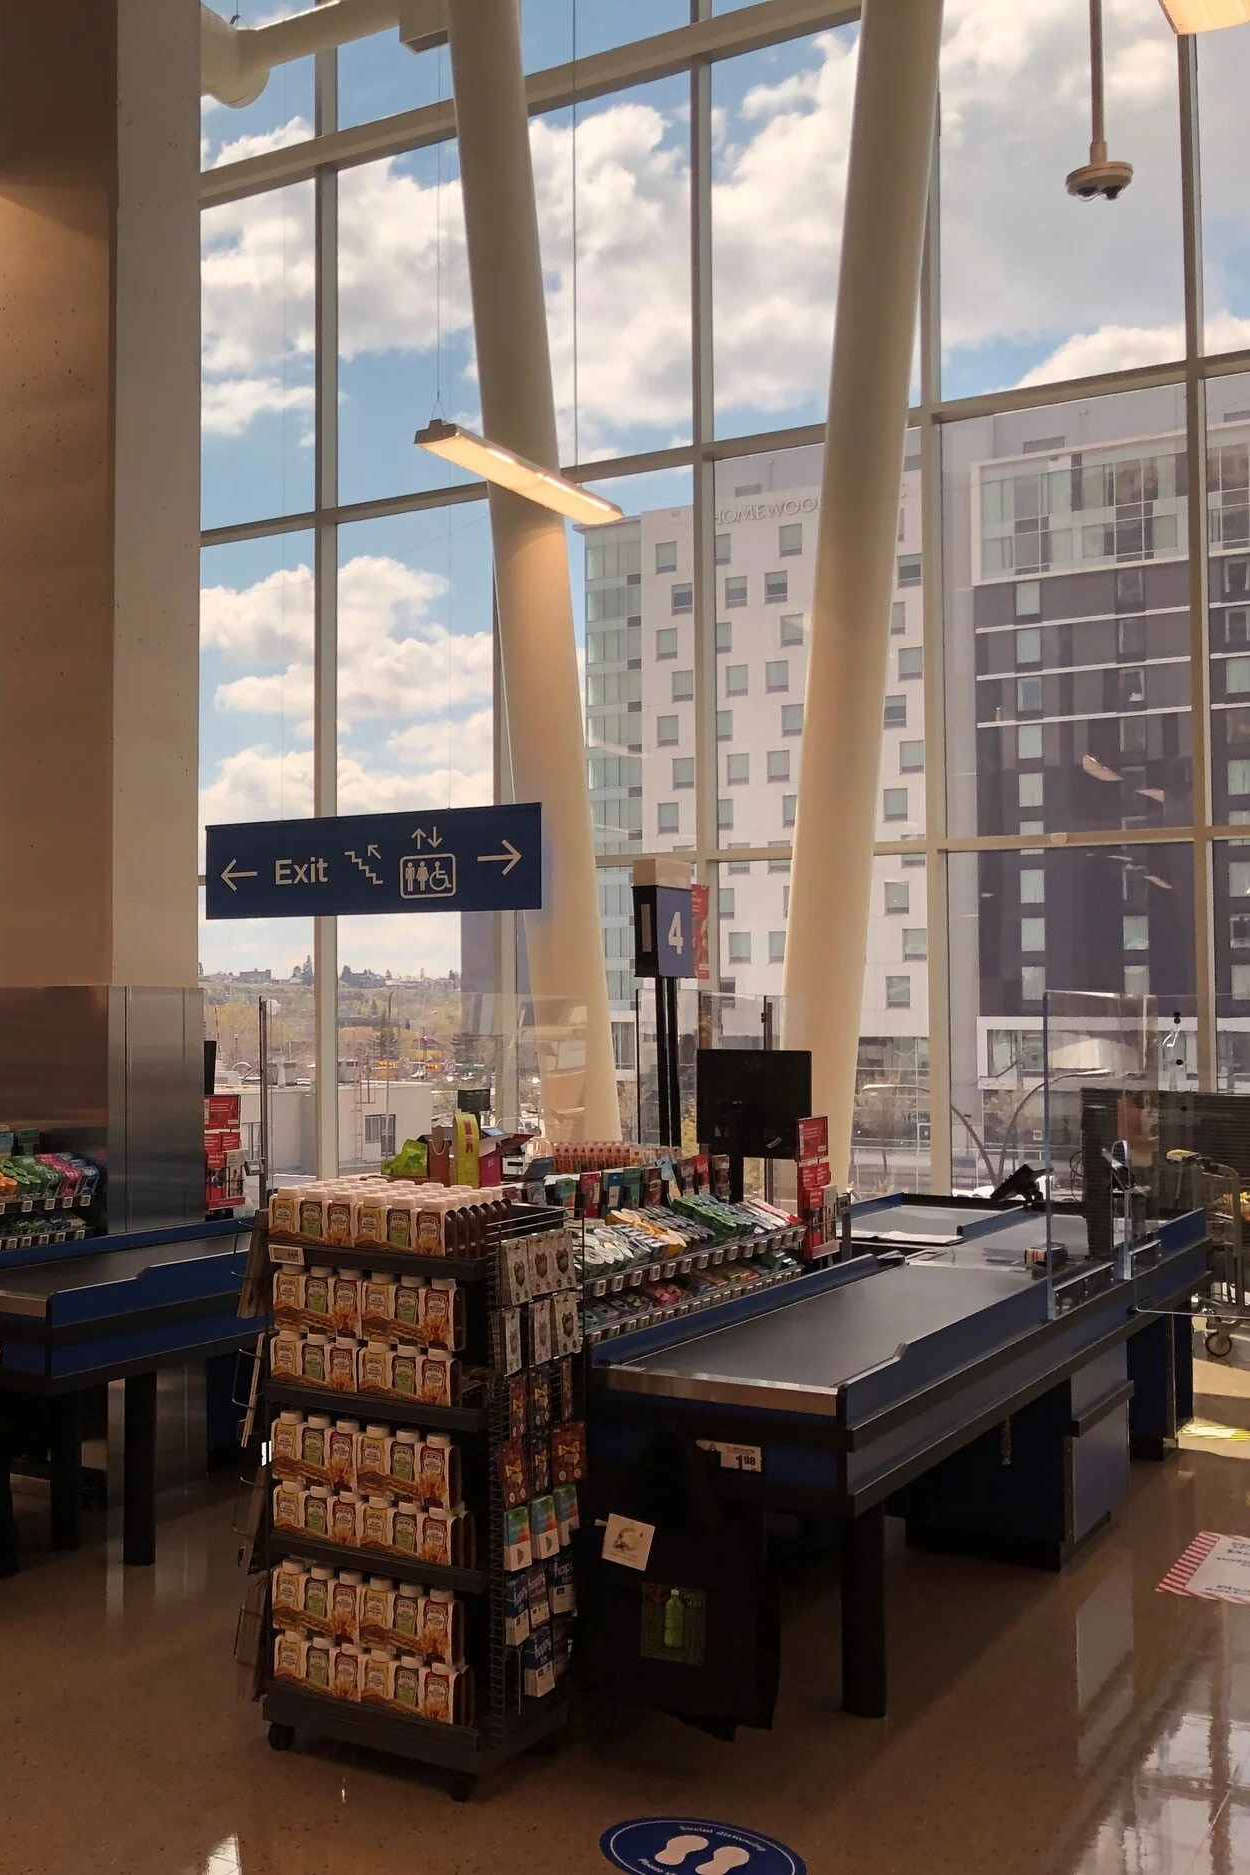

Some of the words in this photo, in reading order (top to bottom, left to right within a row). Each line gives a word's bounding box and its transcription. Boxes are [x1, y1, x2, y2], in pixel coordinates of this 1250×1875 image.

[715, 497, 822, 525] HOMEWOO
[274, 856, 329, 885] Exit
[668, 911, 684, 955] 4
